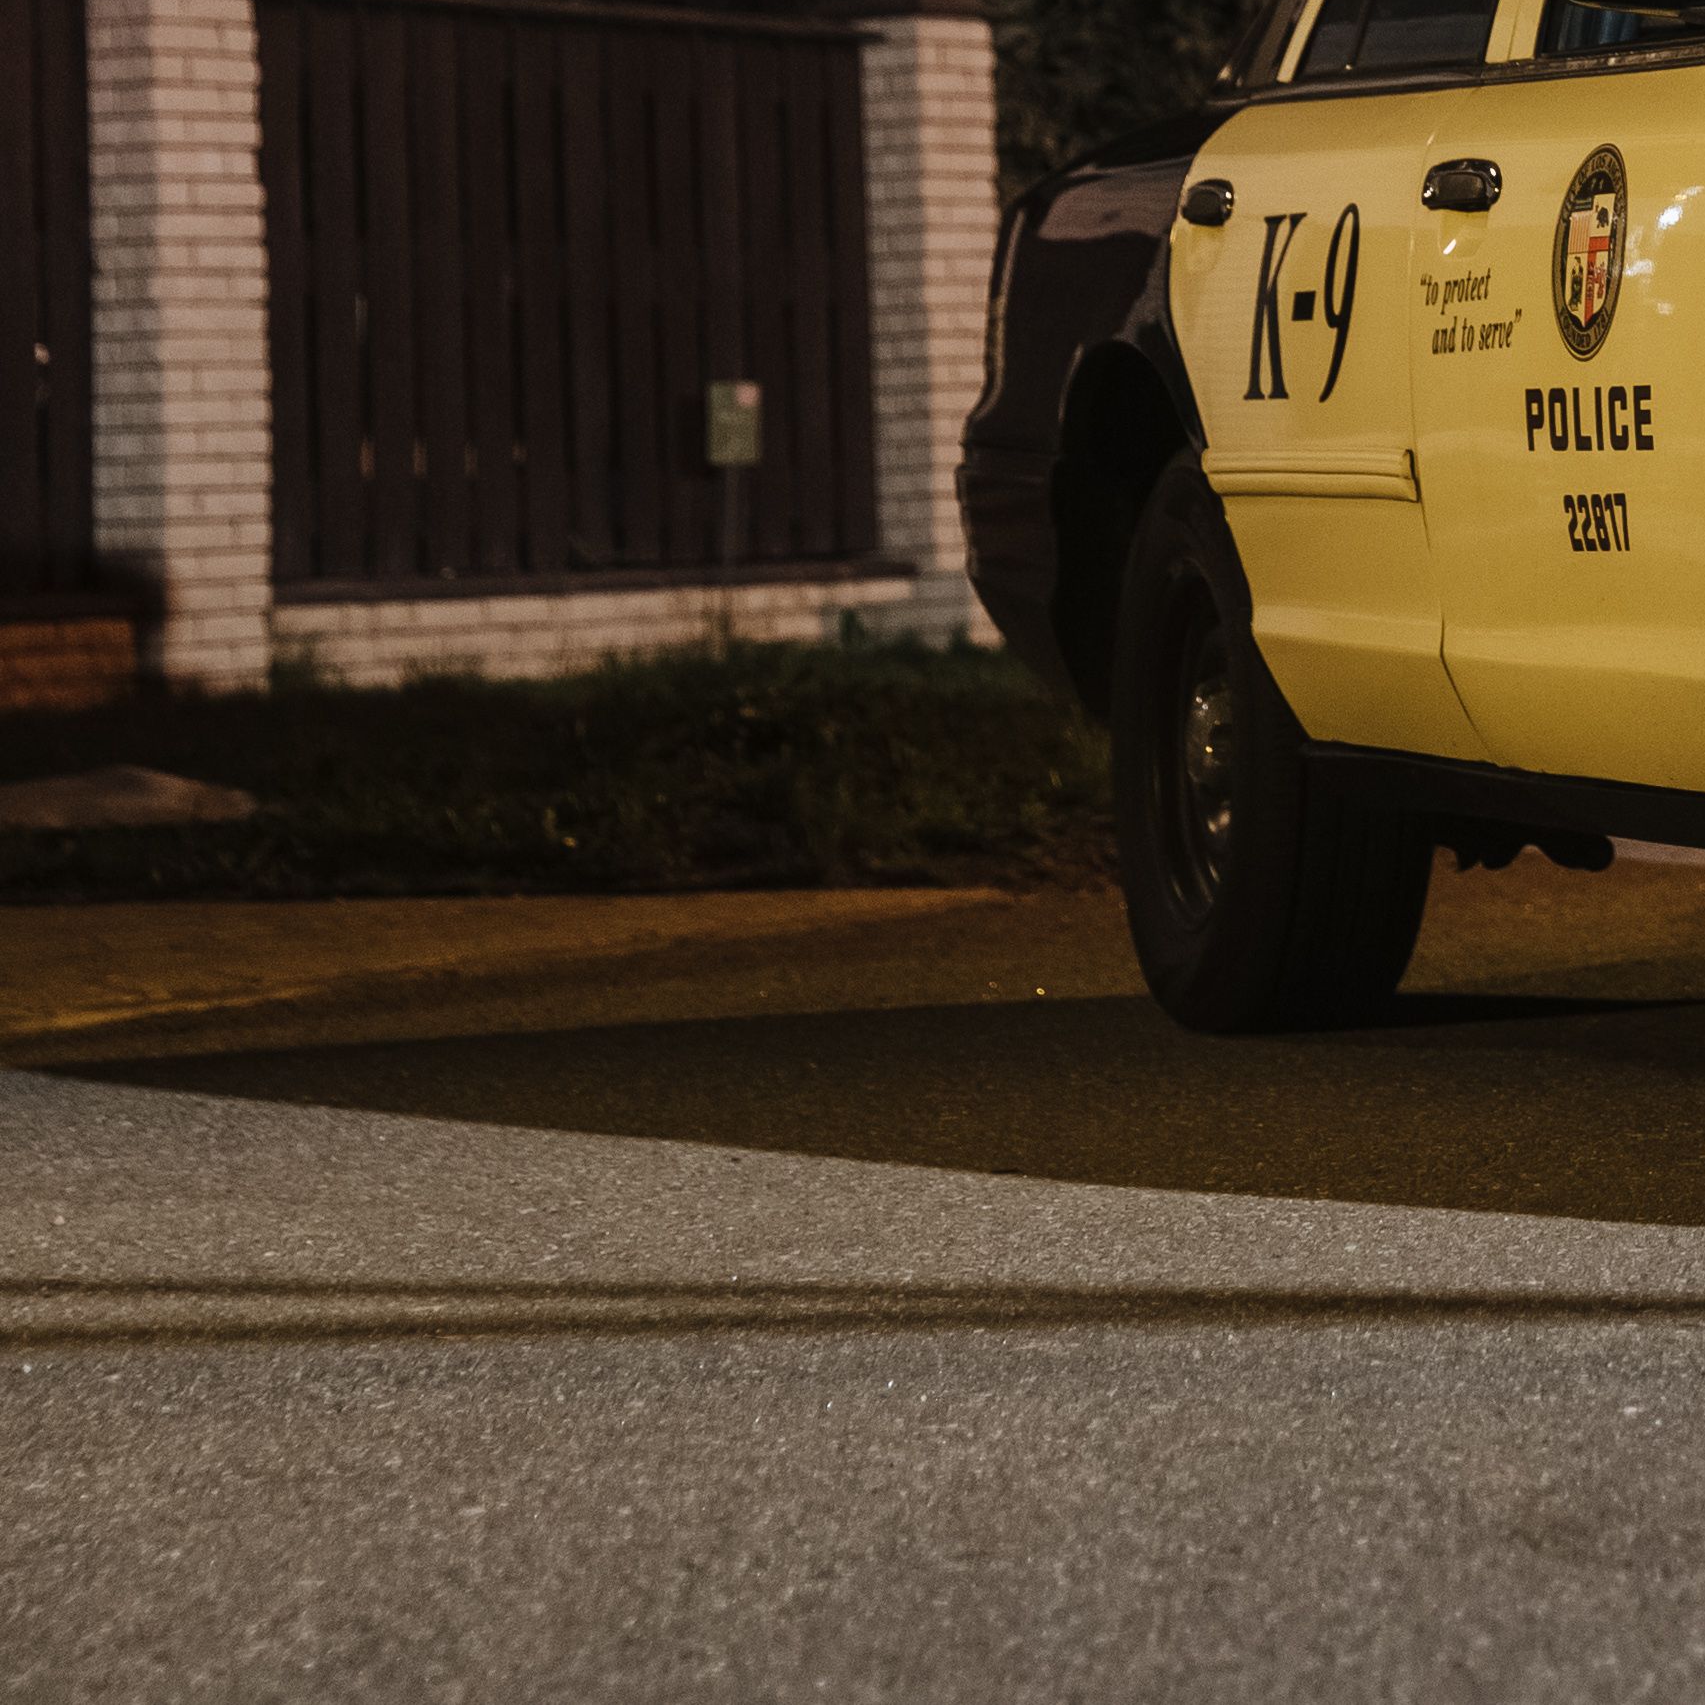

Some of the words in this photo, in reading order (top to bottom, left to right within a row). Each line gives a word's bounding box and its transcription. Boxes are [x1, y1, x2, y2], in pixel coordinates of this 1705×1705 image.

[1243, 203, 1360, 403] K-9
[1440, 267, 1491, 315] protect
[1432, 316, 1457, 354] and
[1461, 318, 1475, 352] to
[1478, 308, 1522, 350] serve”
[1525, 385, 1654, 451] POLICE
[1563, 493, 1630, 551] 22817
